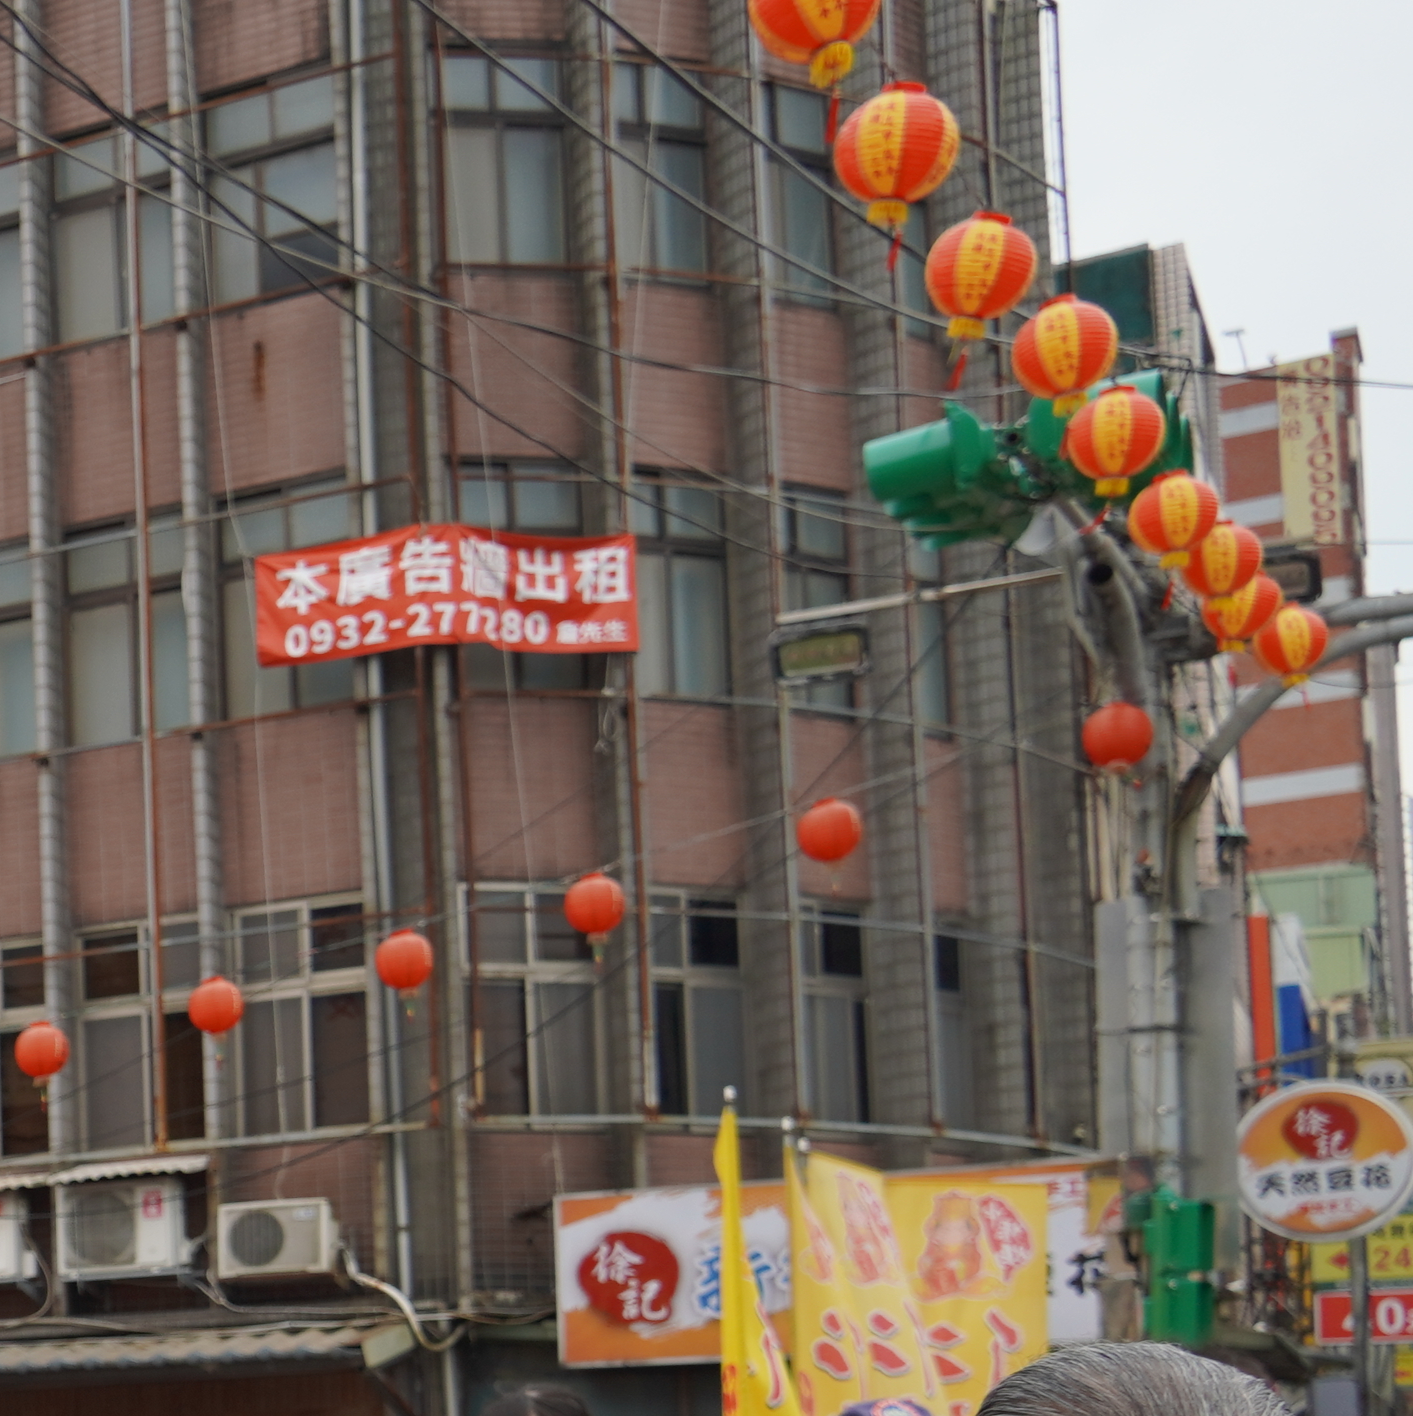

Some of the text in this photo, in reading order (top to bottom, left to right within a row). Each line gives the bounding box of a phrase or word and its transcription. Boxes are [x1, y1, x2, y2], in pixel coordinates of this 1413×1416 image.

[276, 535, 633, 616] 本廣告牆出租
[284, 600, 550, 659] 0932-277280
[589, 1238, 675, 1324] 徐記
